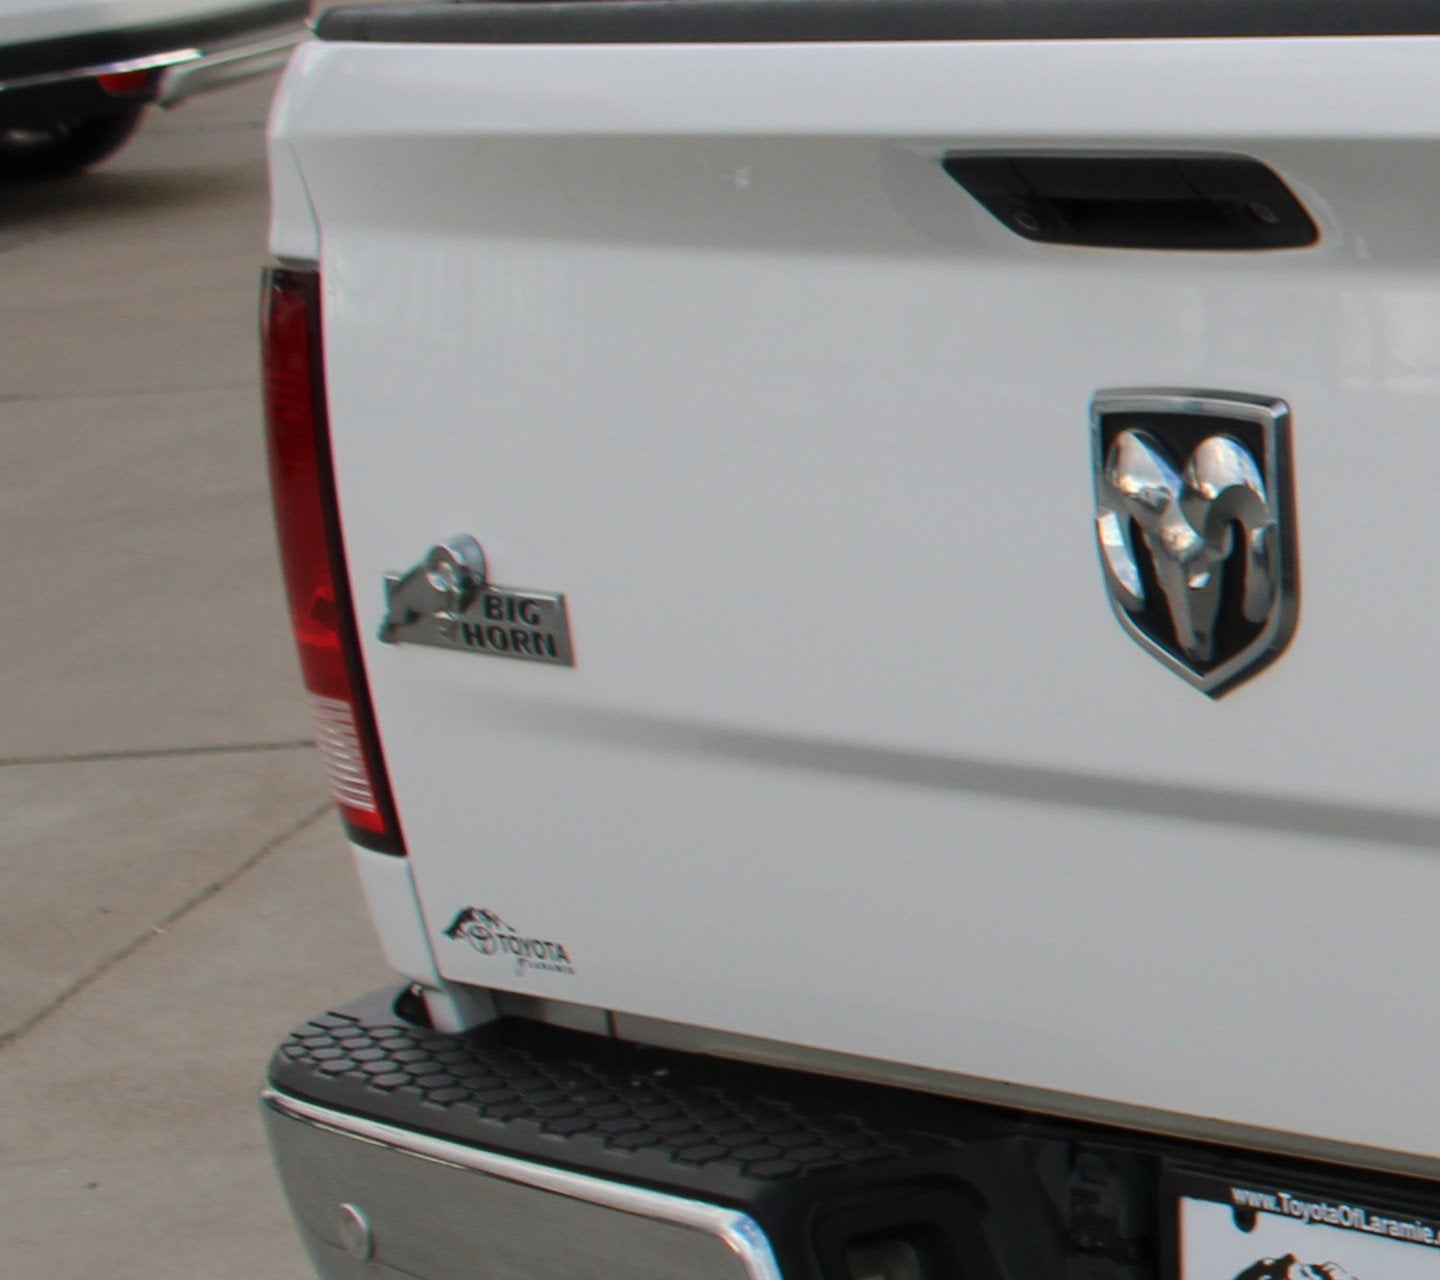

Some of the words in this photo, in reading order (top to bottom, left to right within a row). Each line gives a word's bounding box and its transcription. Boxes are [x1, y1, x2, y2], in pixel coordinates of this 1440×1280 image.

[483, 593, 542, 627] BIG
[462, 622, 558, 659] HORN
[498, 931, 571, 963] TOYOTA
